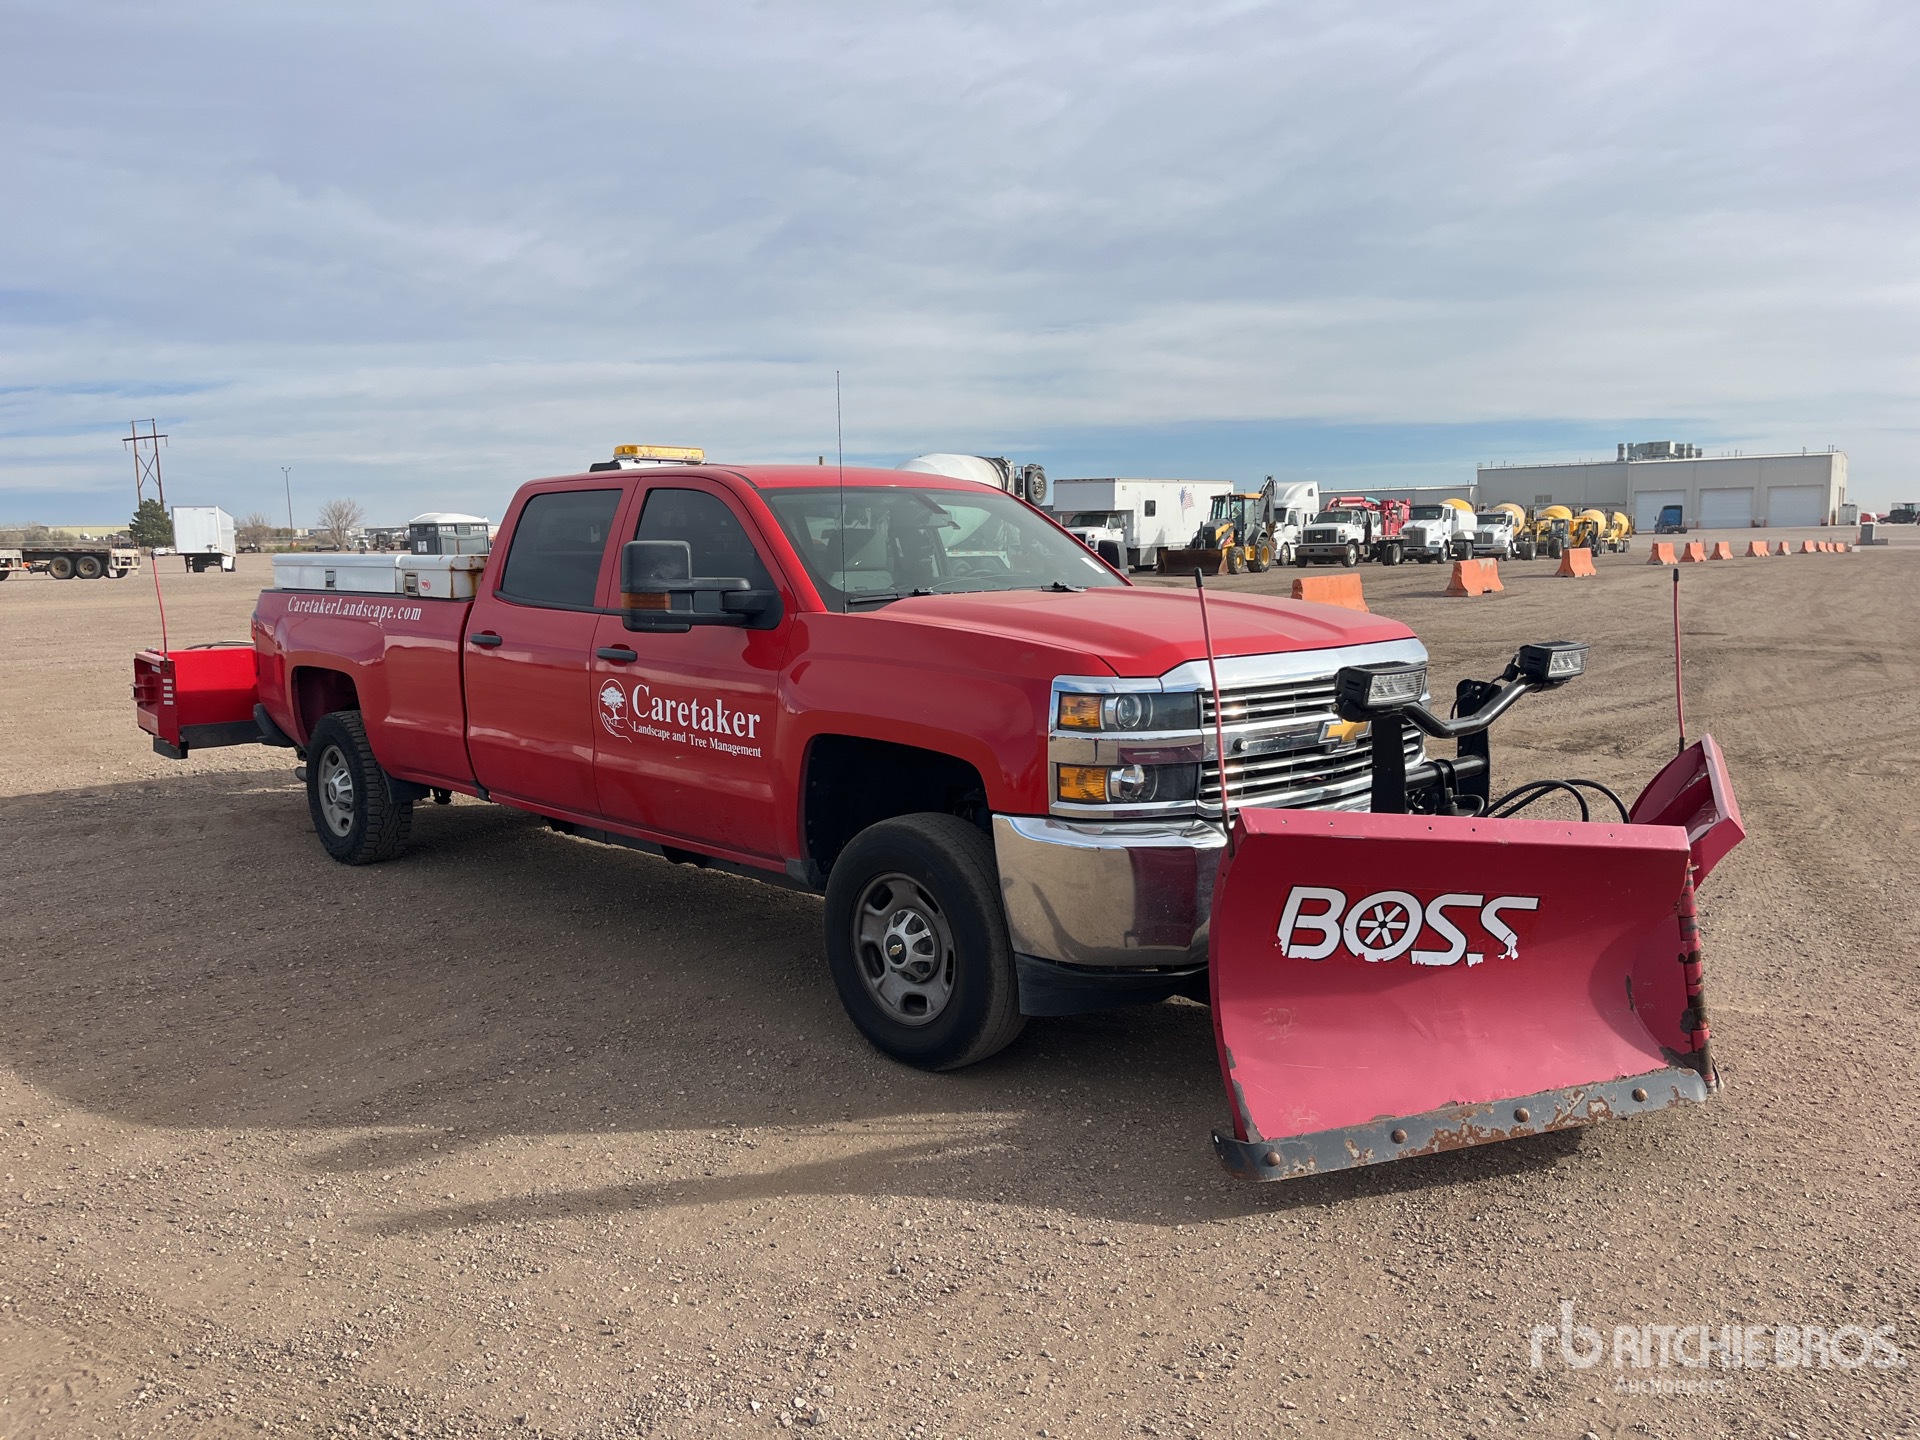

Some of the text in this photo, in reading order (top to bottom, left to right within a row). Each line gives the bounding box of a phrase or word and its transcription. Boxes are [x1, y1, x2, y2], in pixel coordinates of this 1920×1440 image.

[287, 596, 422, 622] CaretakerLandscape.com
[632, 684, 761, 738] Caretaker
[633, 721, 762, 758] Landscape and Tree Management
